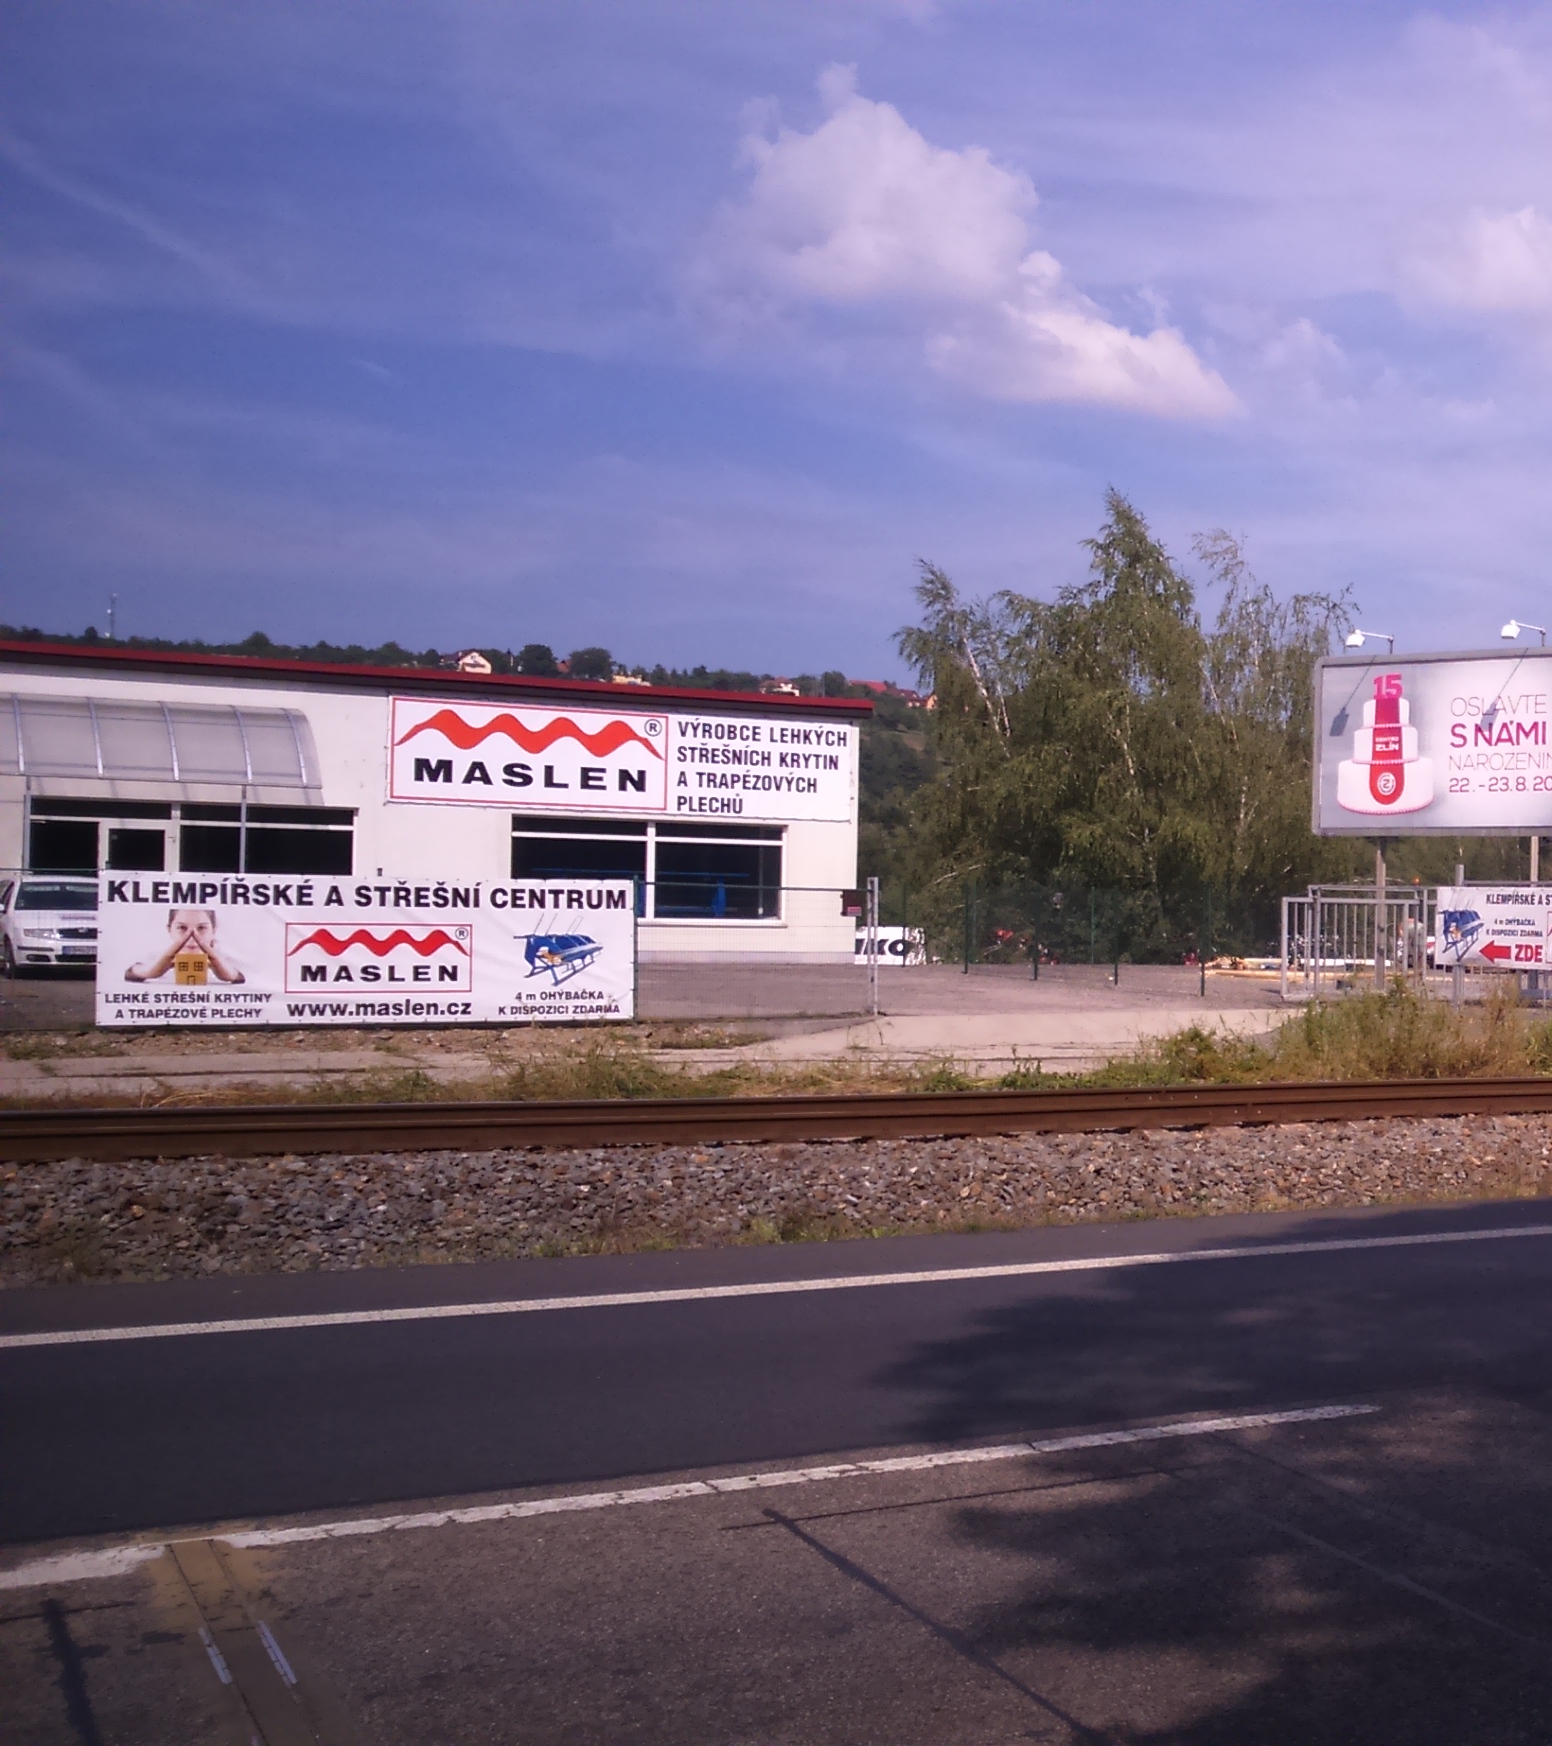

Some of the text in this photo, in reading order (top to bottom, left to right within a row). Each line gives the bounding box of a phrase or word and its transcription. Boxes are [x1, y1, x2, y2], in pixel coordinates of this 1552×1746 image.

[1373, 672, 1403, 699] 15
[1450, 694, 1547, 717] OSLAVTE
[678, 717, 848, 747] VÝROBCE LEHKÝCH
[1450, 720, 1547, 748] S NÁMI
[677, 742, 839, 770] STŘEŠNÍCH KRYTIN
[413, 757, 647, 793] MASLEN
[677, 769, 817, 793] A TRAPÉZOVÝCH
[677, 793, 743, 814] PLECHŮ
[107, 877, 627, 910] KLEMPÍŘSKÉ A STŘEŠNÍ CENTRUM
[1486, 891, 1535, 905] KLEMPÍŘSKÉ
[1537, 894, 1543, 905] A
[1515, 944, 1543, 962] ZDE
[301, 965, 458, 983] MASLEN
[104, 991, 272, 1004] LEHKÉ STŘEŠNÍ KRYTINY
[515, 992, 522, 1000] 4
[540, 988, 604, 1001] OHÝBAČKA
[114, 1006, 262, 1019] A TRAPÉZOVÉ PLECHY
[286, 999, 472, 1017] www.maslen.cz
[498, 1004, 620, 1015] K DISPOZICI ZDARMA
